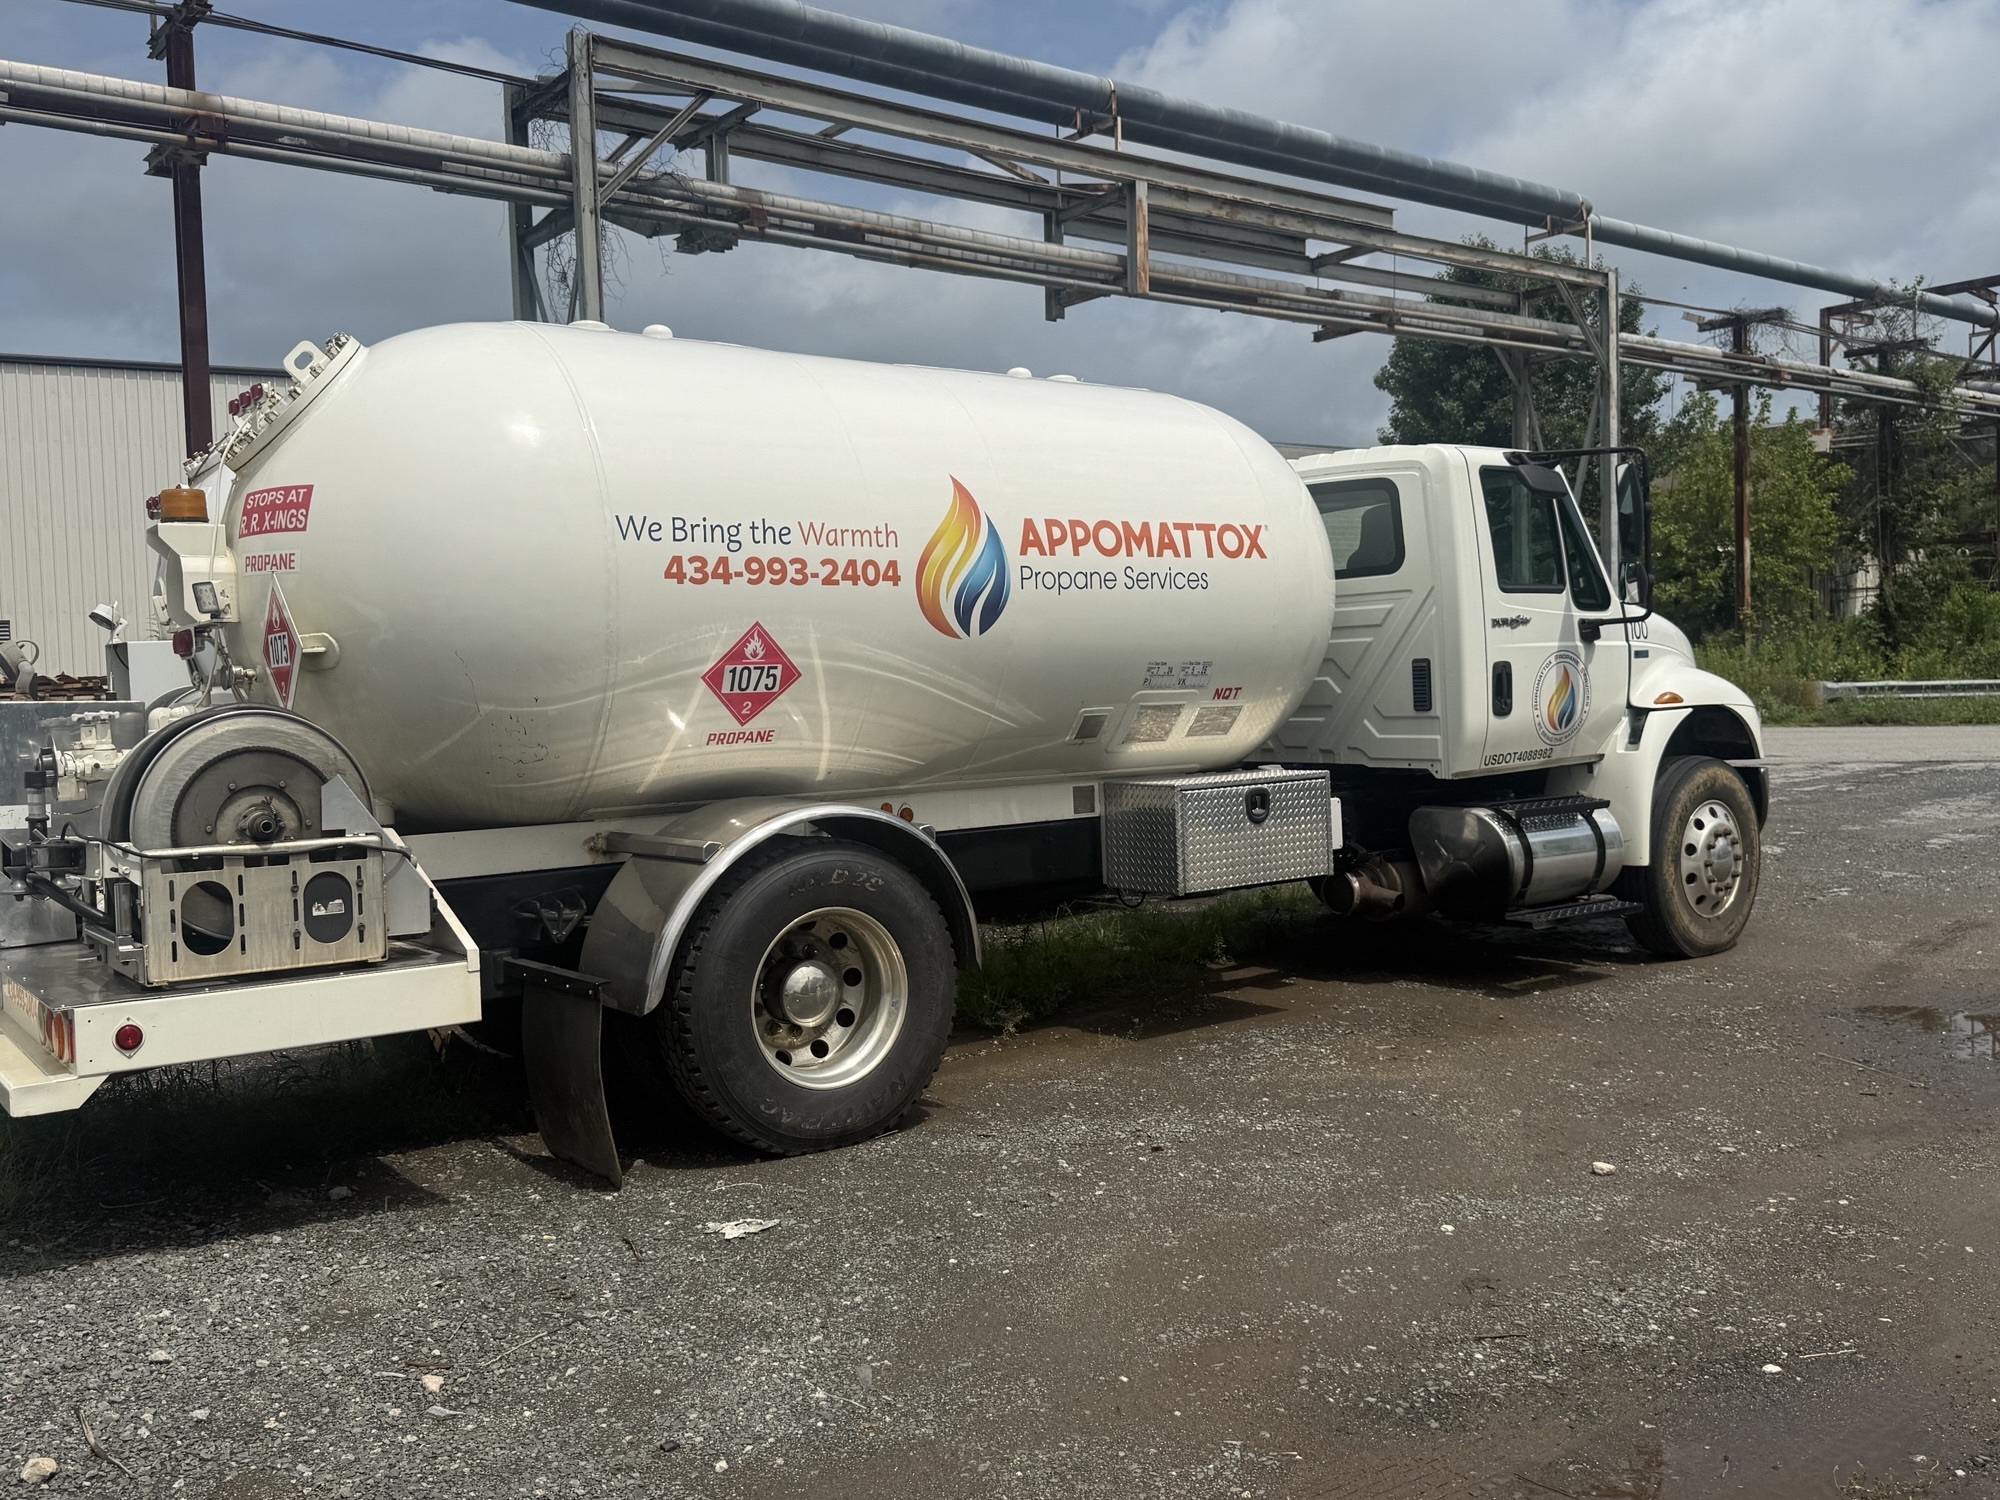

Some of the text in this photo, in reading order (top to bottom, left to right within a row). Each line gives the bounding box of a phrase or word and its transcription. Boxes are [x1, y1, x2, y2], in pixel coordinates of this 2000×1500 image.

[247, 488, 307, 509] STOPS AT
[240, 509, 306, 534] R. R. X-INGS
[615, 515, 899, 552] We Bring the Warmth
[1019, 518, 1267, 559] APPOMATTOX
[245, 553, 296, 573] PROPANE
[664, 555, 901, 587] 434-993-2404
[1020, 566, 1209, 595] Propane Services
[270, 634, 289, 666] 1075
[281, 682, 287, 697] 2
[728, 665, 778, 692] 1075
[741, 701, 753, 714] 2
[706, 730, 775, 746] PROPANE
[1484, 748, 1553, 767] USDOT4088982
